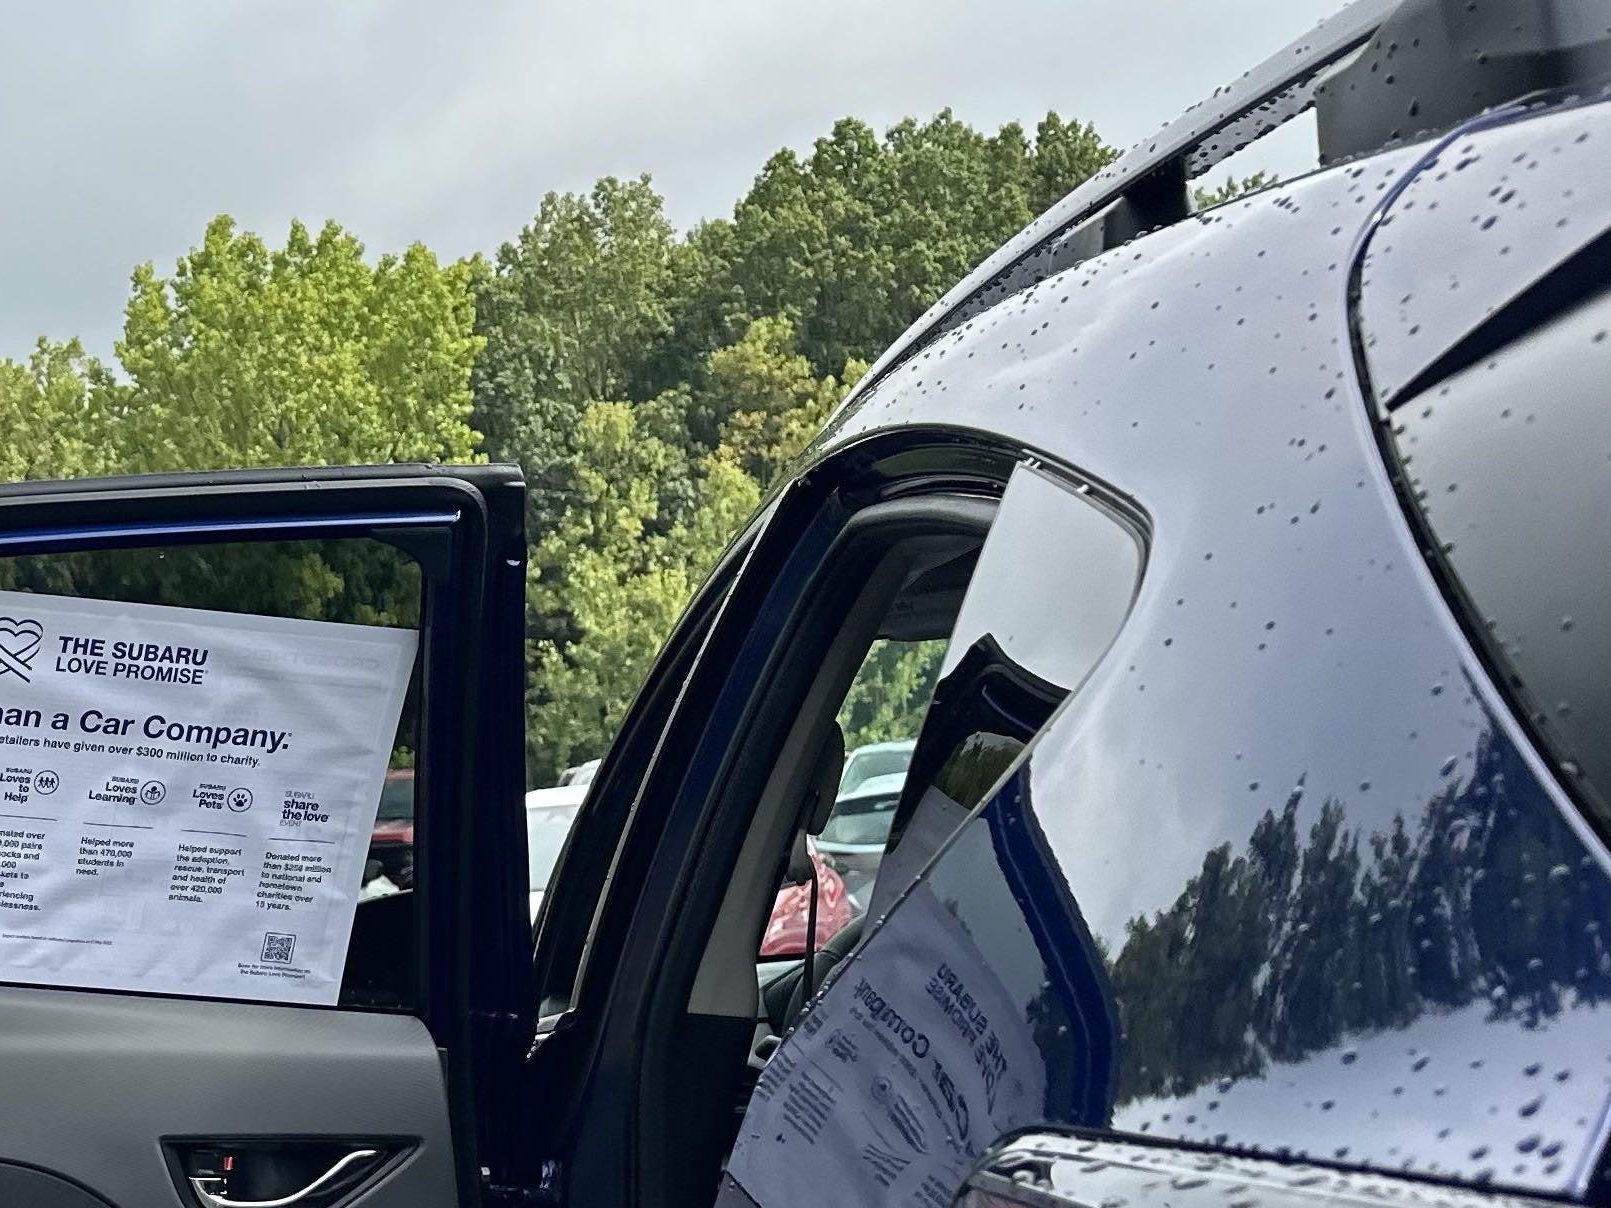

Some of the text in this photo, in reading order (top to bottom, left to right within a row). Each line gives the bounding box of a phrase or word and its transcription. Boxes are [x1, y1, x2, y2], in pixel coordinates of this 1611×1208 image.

[59, 636, 209, 666] THE SUBARU
[55, 656, 205, 684] LOVE PROMISE
[50, 712, 70, 730] a
[79, 710, 135, 736] Car
[143, 714, 289, 753] Company.
[43, 738, 70, 749] have
[73, 740, 104, 754] given
[108, 743, 133, 755] over
[136, 746, 163, 759] $300
[166, 750, 203, 762] million
[206, 753, 217, 762] to
[221, 754, 261, 768] charity.
[0, 773, 31, 783] Loves
[19, 784, 29, 792] to
[106, 782, 137, 793] Loves
[4, 792, 28, 803] Help
[89, 790, 137, 805] Learning
[193, 789, 224, 800] Loves
[199, 800, 223, 809] Pets
[283, 799, 319, 811] share
[282, 809, 329, 822] the love
[81, 837, 111, 847] Helped
[80, 847, 98, 856] than
[178, 844, 241, 856] Helped support
[24, 852, 40, 860] and
[177, 854, 189, 862] the
[266, 852, 300, 862] Donated
[263, 862, 282, 870] than
[207, 867, 244, 876] transport
[190, 876, 216, 884] health
[272, 873, 305, 882] national
[257, 891, 313, 903] charities over
